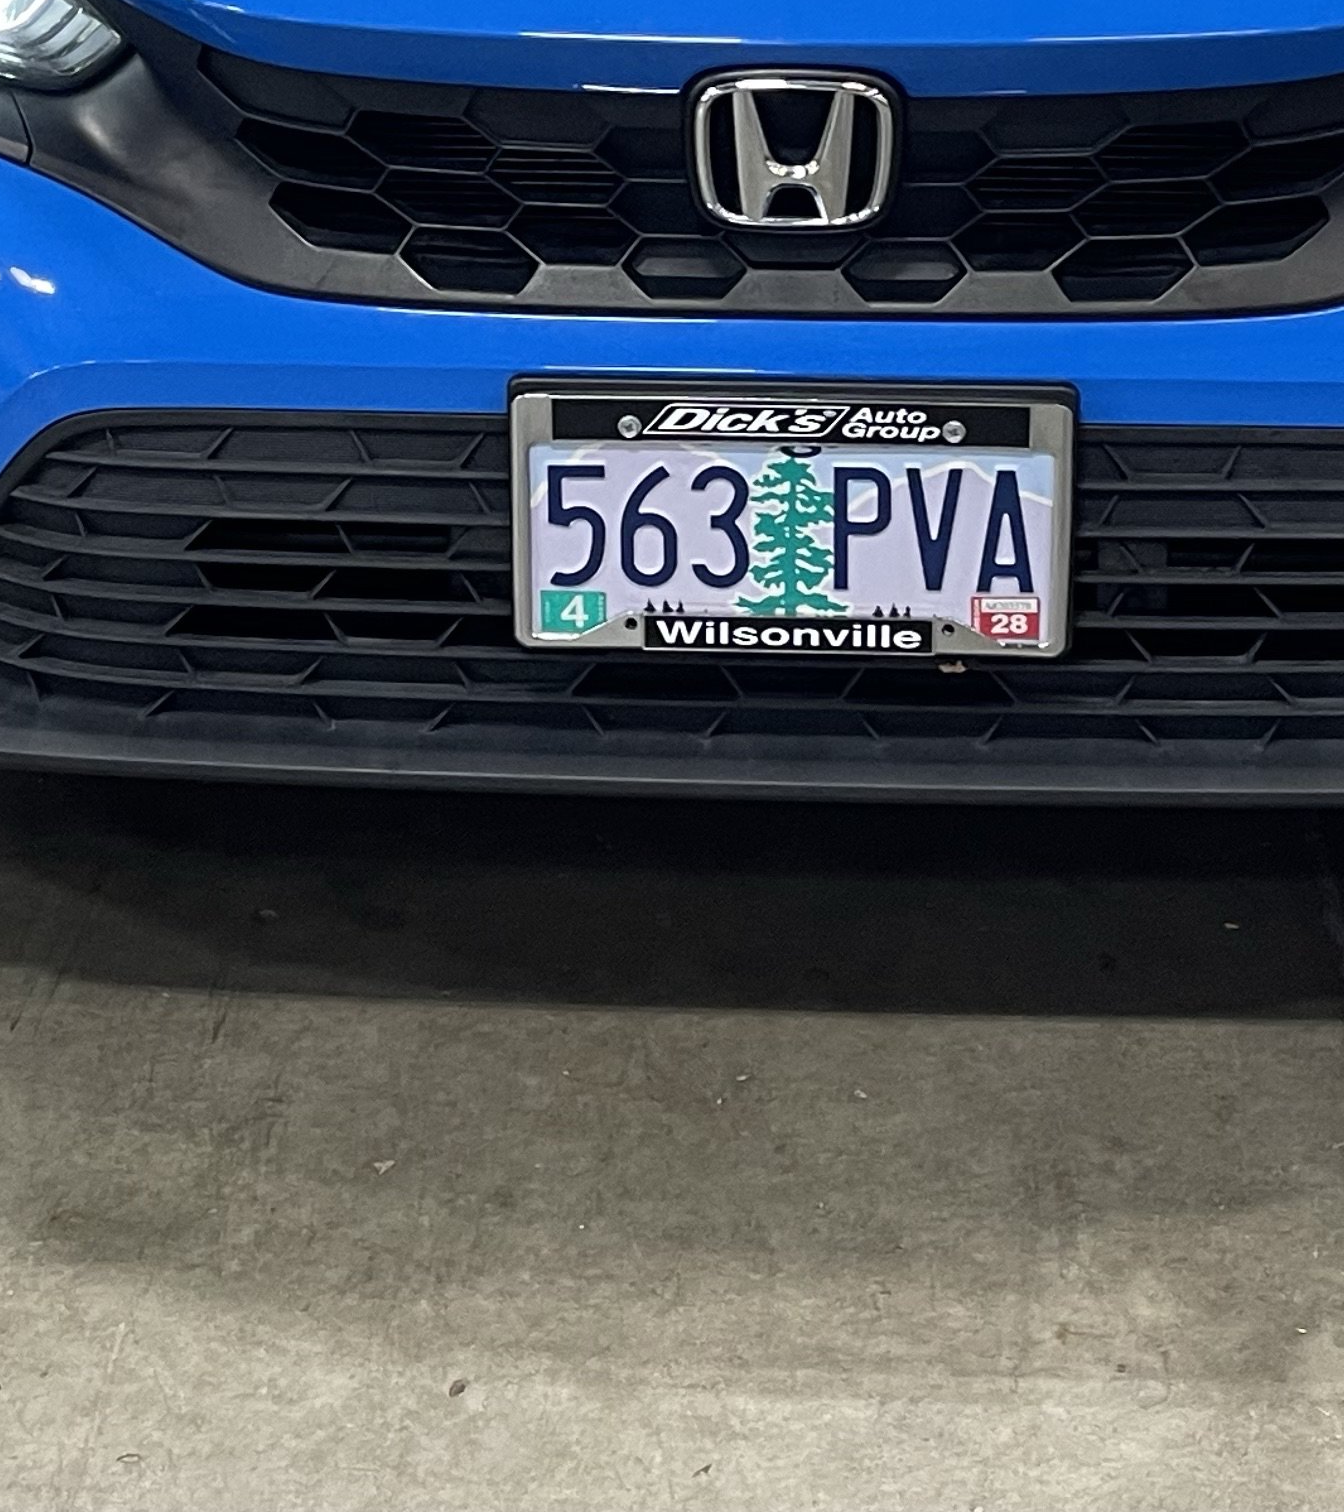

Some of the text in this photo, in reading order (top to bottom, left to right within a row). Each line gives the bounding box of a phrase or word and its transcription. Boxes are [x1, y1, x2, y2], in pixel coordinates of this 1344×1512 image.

[657, 407, 826, 433] Dick's
[849, 407, 928, 425] Auto
[841, 422, 942, 443] Group
[546, 464, 1034, 593] 563 PVA
[560, 594, 590, 628] 4
[990, 613, 1029, 635] 28
[656, 620, 923, 650] Wilsonville
